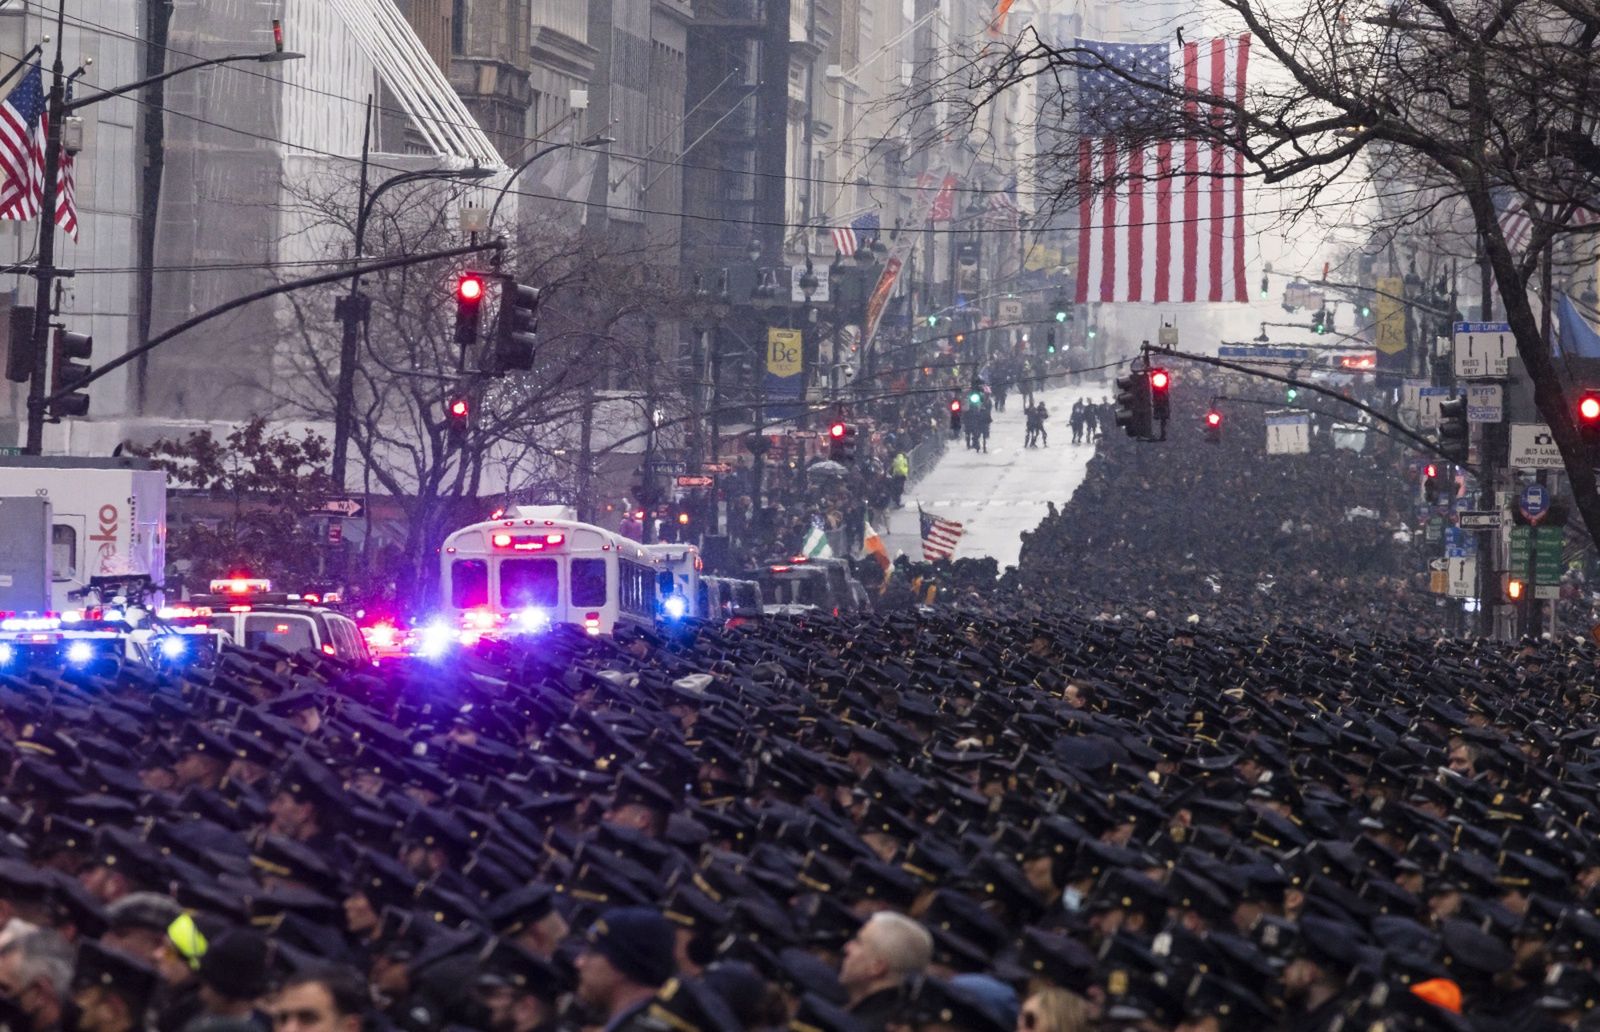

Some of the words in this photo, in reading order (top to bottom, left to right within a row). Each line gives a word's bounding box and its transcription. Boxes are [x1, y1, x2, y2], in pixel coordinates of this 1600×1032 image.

[772, 341, 798, 362] Be
[1472, 387, 1497, 396] NYPD
[1463, 516, 1480, 525] ONE
[1489, 516, 1501, 524] WA
